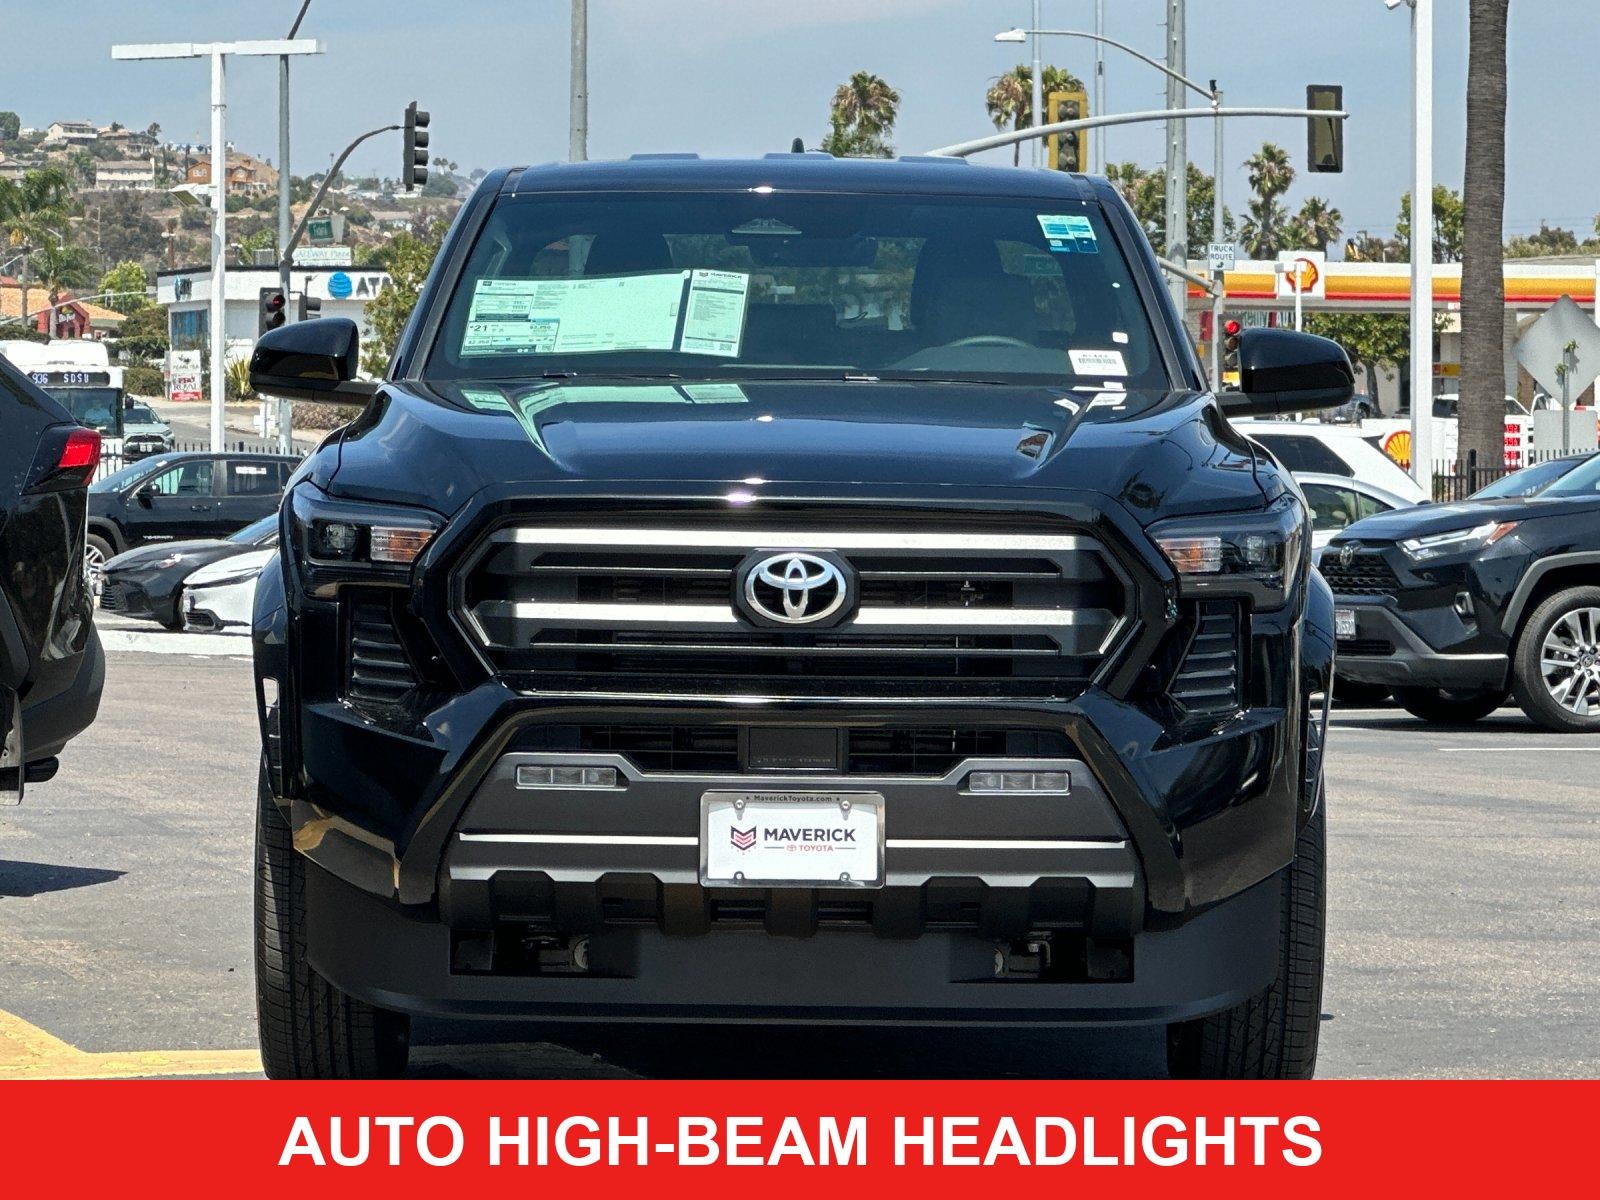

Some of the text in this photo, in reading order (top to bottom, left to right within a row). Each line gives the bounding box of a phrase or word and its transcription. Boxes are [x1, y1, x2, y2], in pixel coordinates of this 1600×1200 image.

[31, 373, 89, 384] 936 SDSU
[753, 794, 833, 803] MaverickToyota.com
[764, 828, 857, 842] MAVERICK
